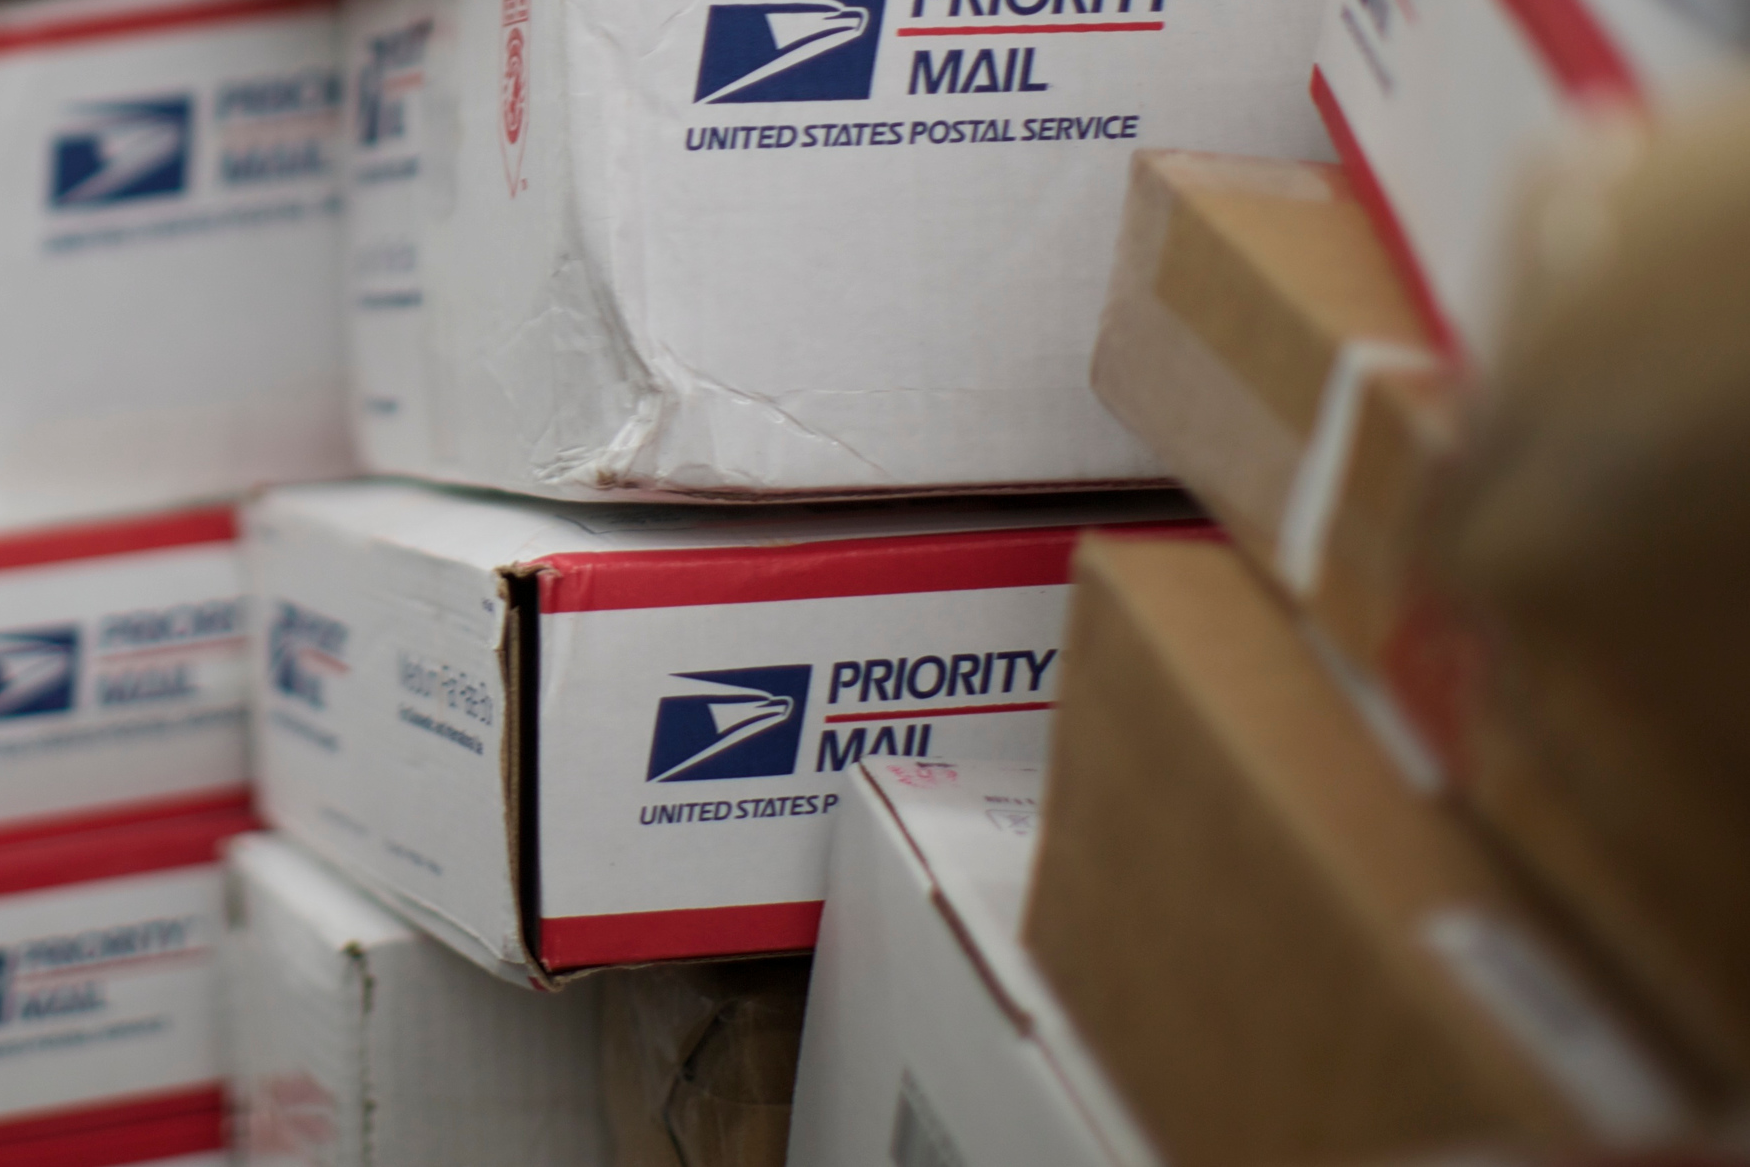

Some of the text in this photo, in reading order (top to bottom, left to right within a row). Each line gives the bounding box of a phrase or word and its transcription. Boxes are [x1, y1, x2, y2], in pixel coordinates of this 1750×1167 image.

[907, 47, 1051, 95] MAIL
[685, 115, 1140, 151] UNITED STATES POSTAL SERVICE
[828, 649, 1058, 704] PRIORITY
[639, 800, 733, 826] UNITED
[735, 795, 819, 820] STATES
